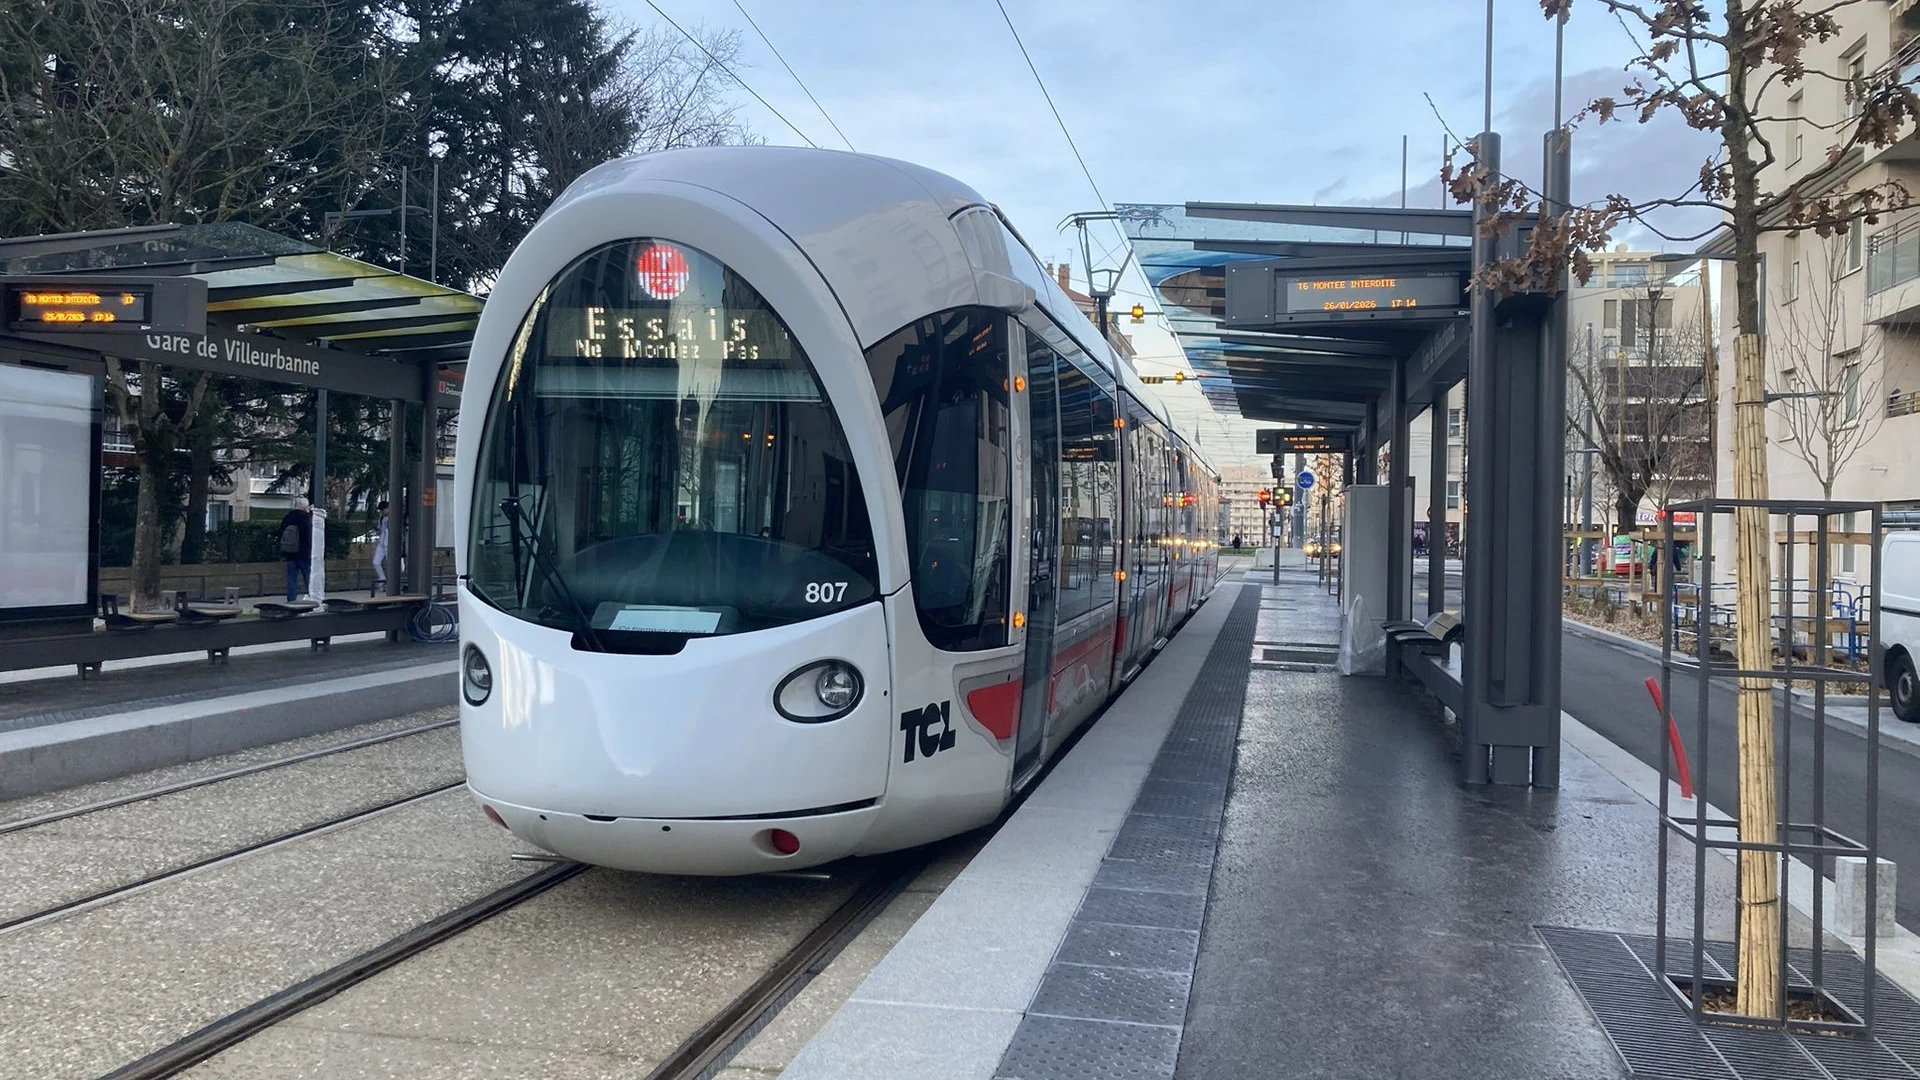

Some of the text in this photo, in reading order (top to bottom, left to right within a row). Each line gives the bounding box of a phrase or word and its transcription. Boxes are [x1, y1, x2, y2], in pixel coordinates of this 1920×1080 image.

[1298, 278, 1397, 291] T6 MONTEE INTERDITE
[1323, 298, 1416, 310] 26/01/2026 17:14
[588, 307, 746, 341] Essais
[147, 334, 320, 376] Gare de Villeurbanne
[575, 340, 759, 360] Ne Montez Pas
[805, 581, 848, 603] 807
[900, 700, 956, 764] TCL
